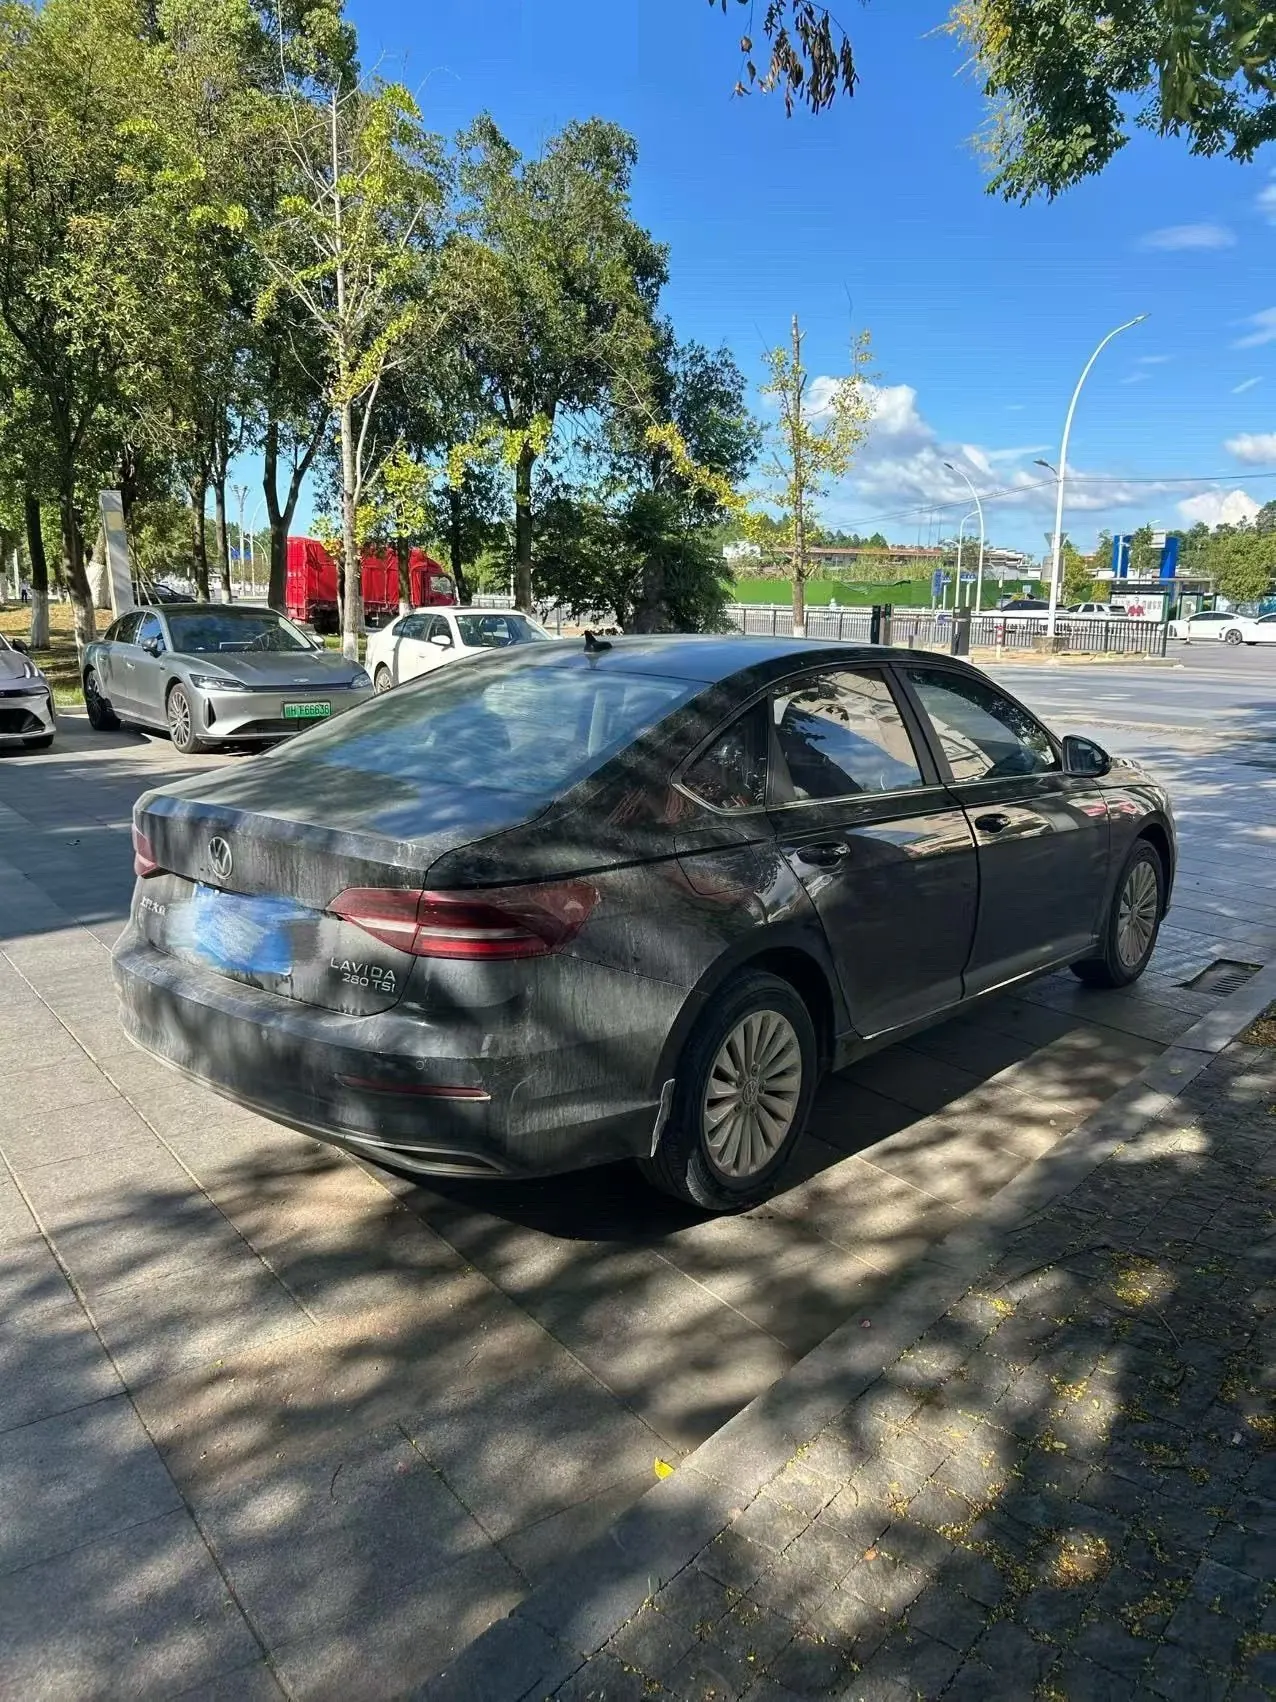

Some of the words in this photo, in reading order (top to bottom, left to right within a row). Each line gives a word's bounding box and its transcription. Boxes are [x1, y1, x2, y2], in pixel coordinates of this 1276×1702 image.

[330, 957, 396, 982] LAVIDA
[342, 972, 369, 987] 280
[372, 979, 396, 993] TSI
